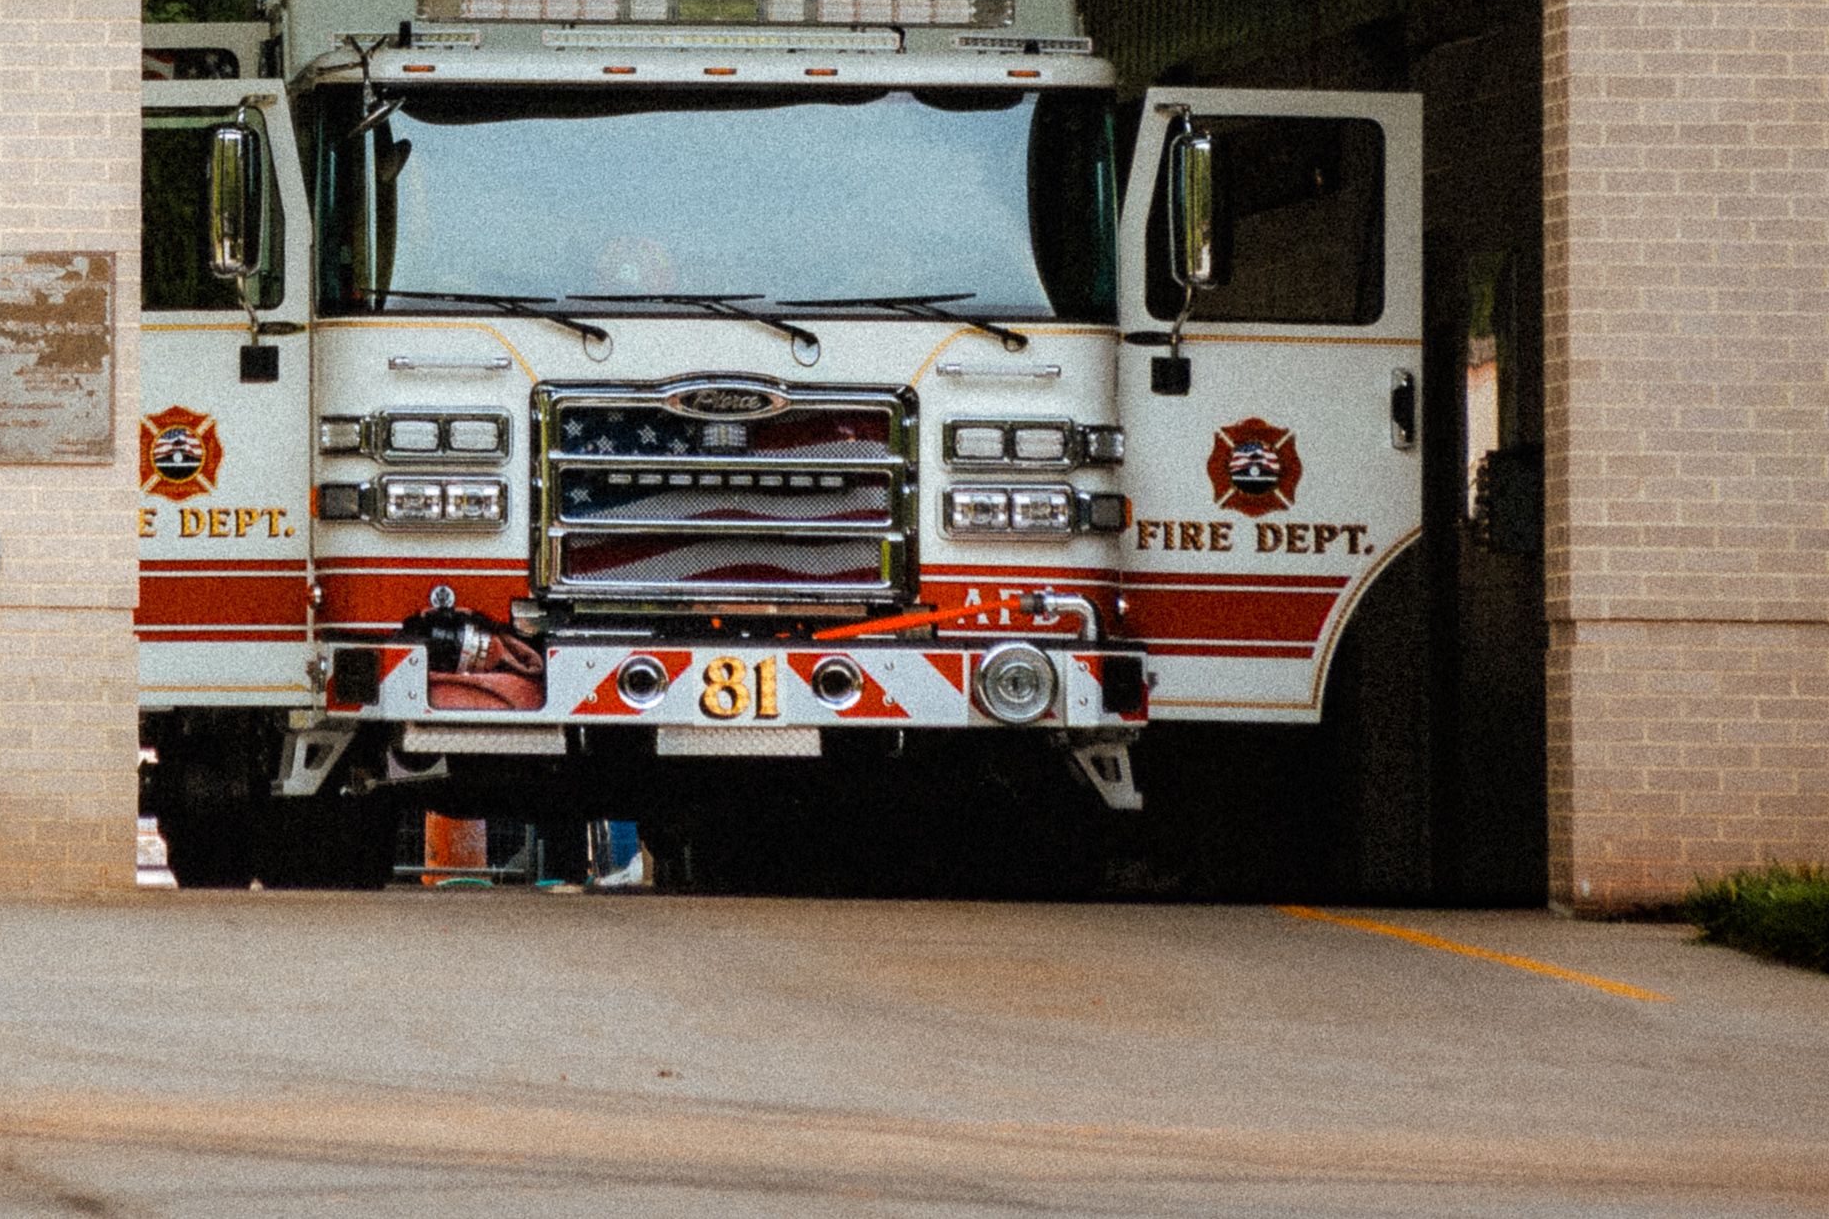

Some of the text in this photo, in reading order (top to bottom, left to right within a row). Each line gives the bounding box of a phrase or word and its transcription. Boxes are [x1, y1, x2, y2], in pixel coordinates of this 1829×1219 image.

[179, 508, 296, 538] DEPT.
[1136, 520, 1375, 555] FIRE DEPT.
[698, 655, 781, 721] 81
